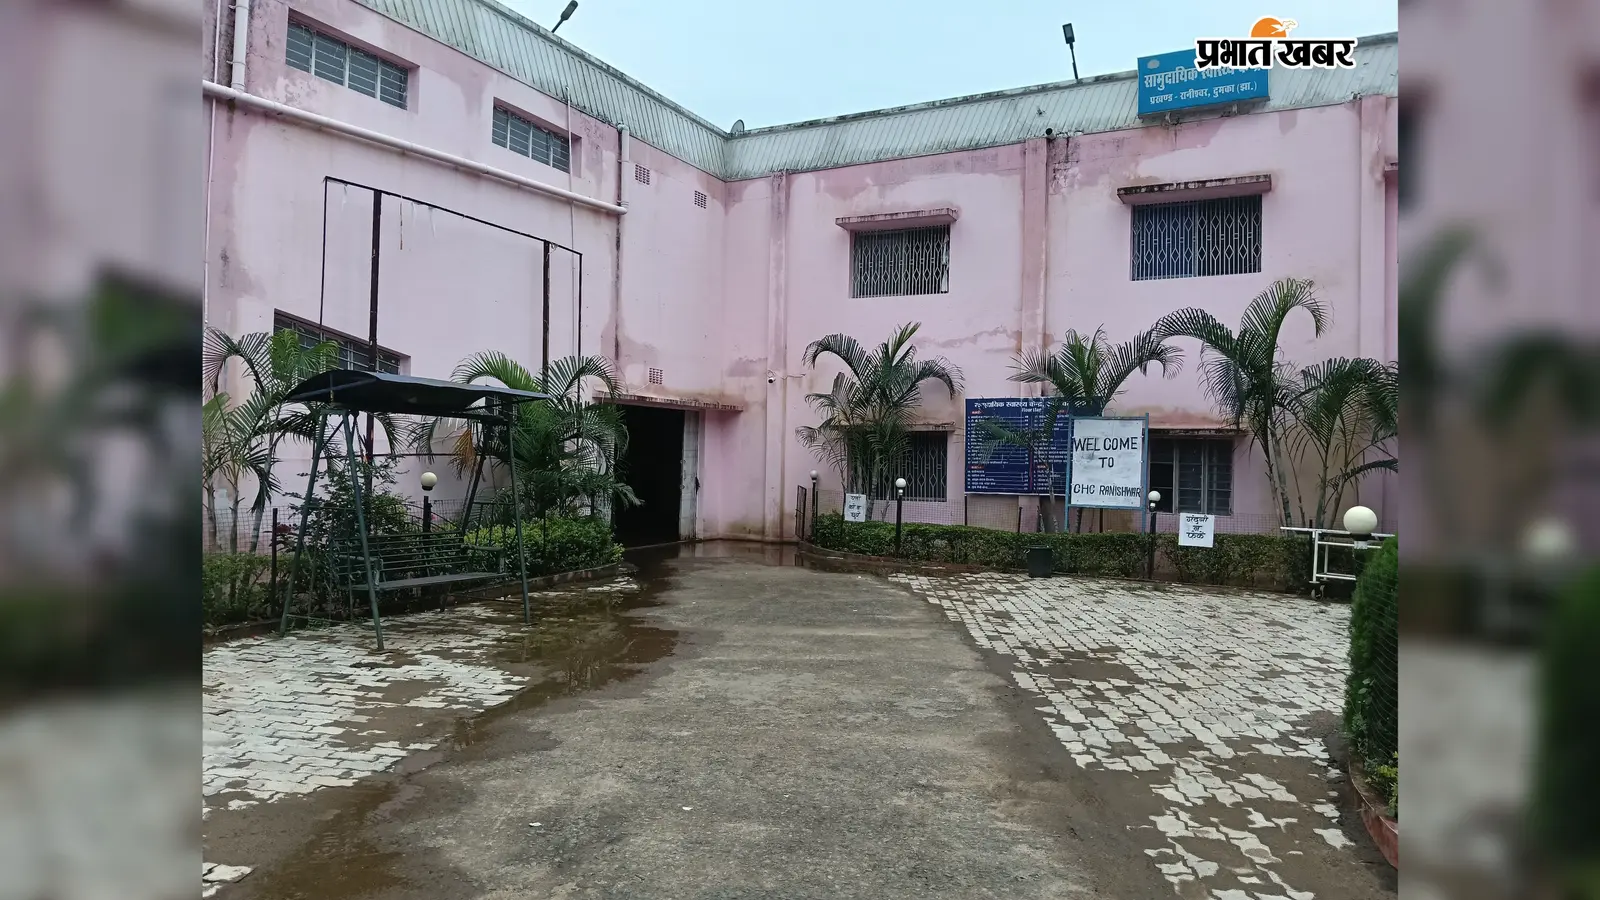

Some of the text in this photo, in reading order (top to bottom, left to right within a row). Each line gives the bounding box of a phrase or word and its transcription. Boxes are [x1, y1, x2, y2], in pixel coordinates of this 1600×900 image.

[1144, 66, 1198, 90] सामुदायिक
[1150, 93, 1173, 104] प्रखण्ड
[1180, 88, 1211, 100] रानीश्वर,
[1213, 84, 1235, 98] दुमका
[1236, 81, 1257, 94] (झा.)
[1098, 457, 1114, 468] TO
[1073, 483, 1141, 498] CHC RANISHWAR
